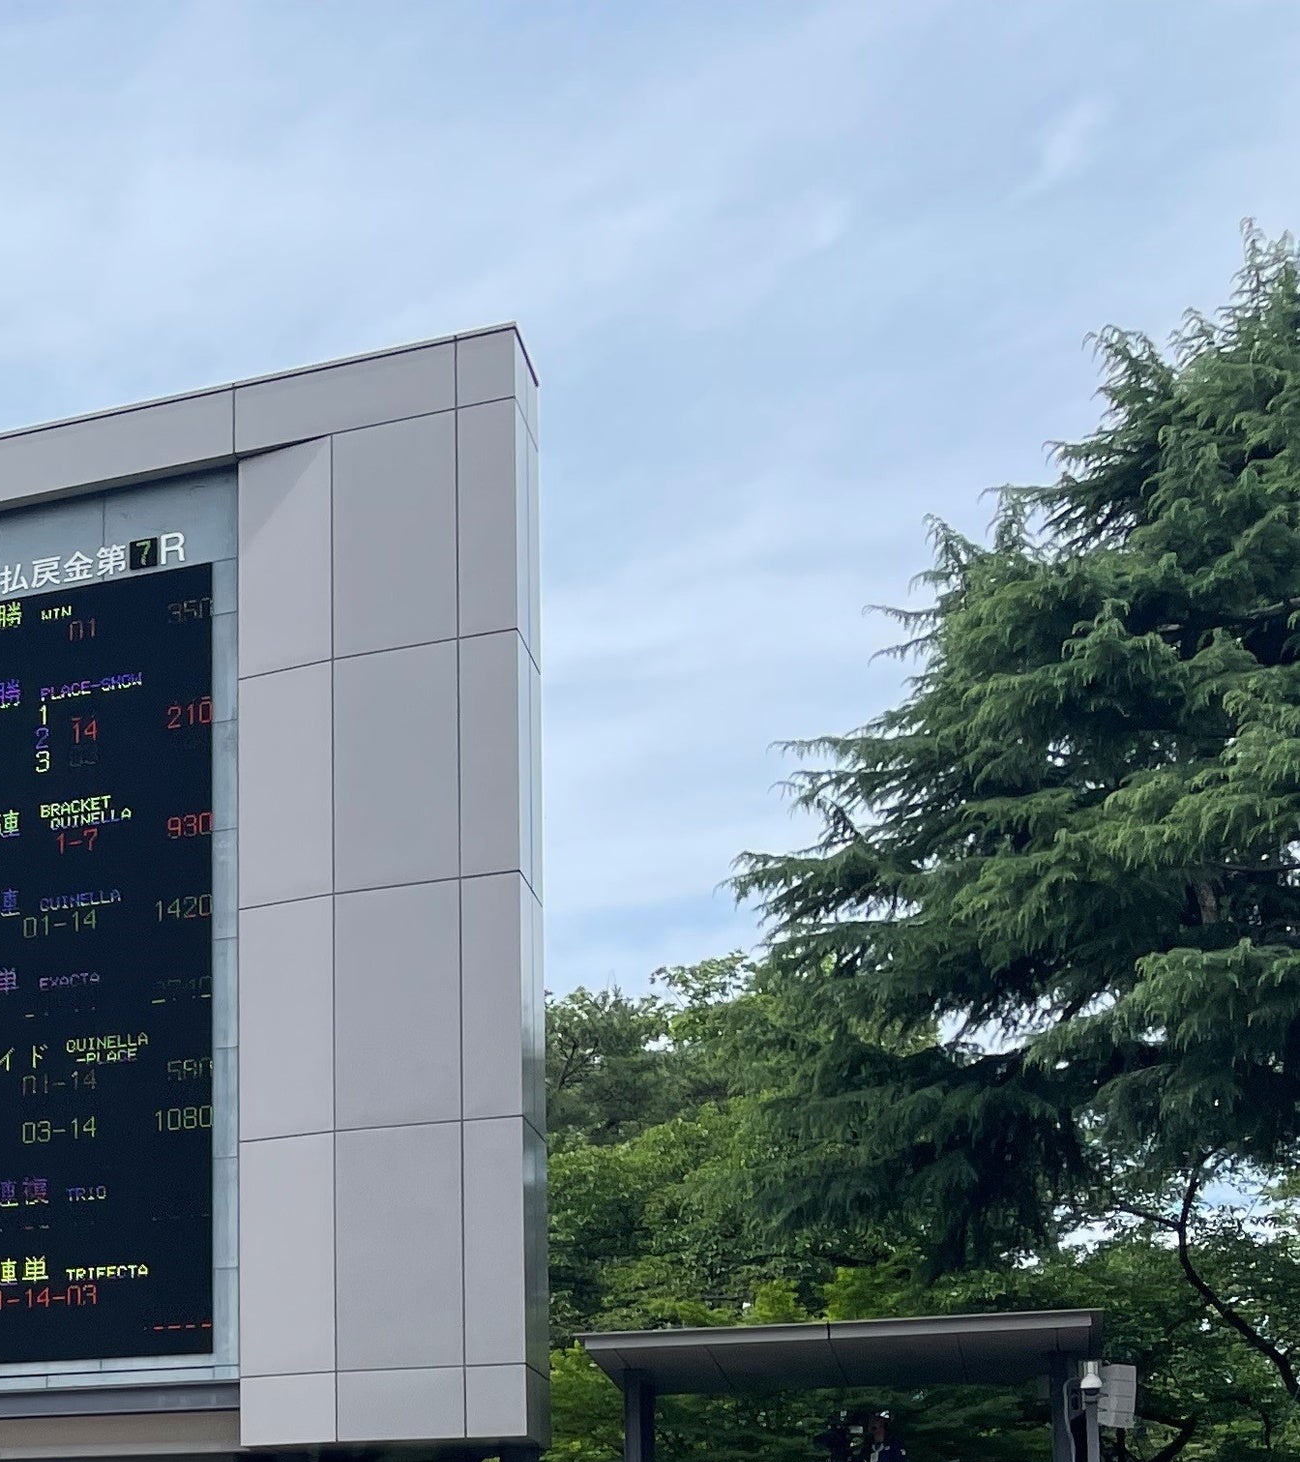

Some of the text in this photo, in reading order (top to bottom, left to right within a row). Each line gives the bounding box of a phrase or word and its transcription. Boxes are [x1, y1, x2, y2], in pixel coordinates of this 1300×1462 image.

[39, 705, 47, 725] 1
[36, 727, 49, 749] 2
[36, 751, 49, 772] 3
[40, 795, 111, 818] BRACKET
[51, 808, 131, 830] QUINELLA
[56, 812, 213, 854] 1-7 930
[23, 894, 213, 938] 01-14 1420
[66, 1032, 148, 1053] QUINELLA
[22, 1105, 213, 1144] 03-14 1080
[66, 1264, 148, 1281] TRIFECTA
